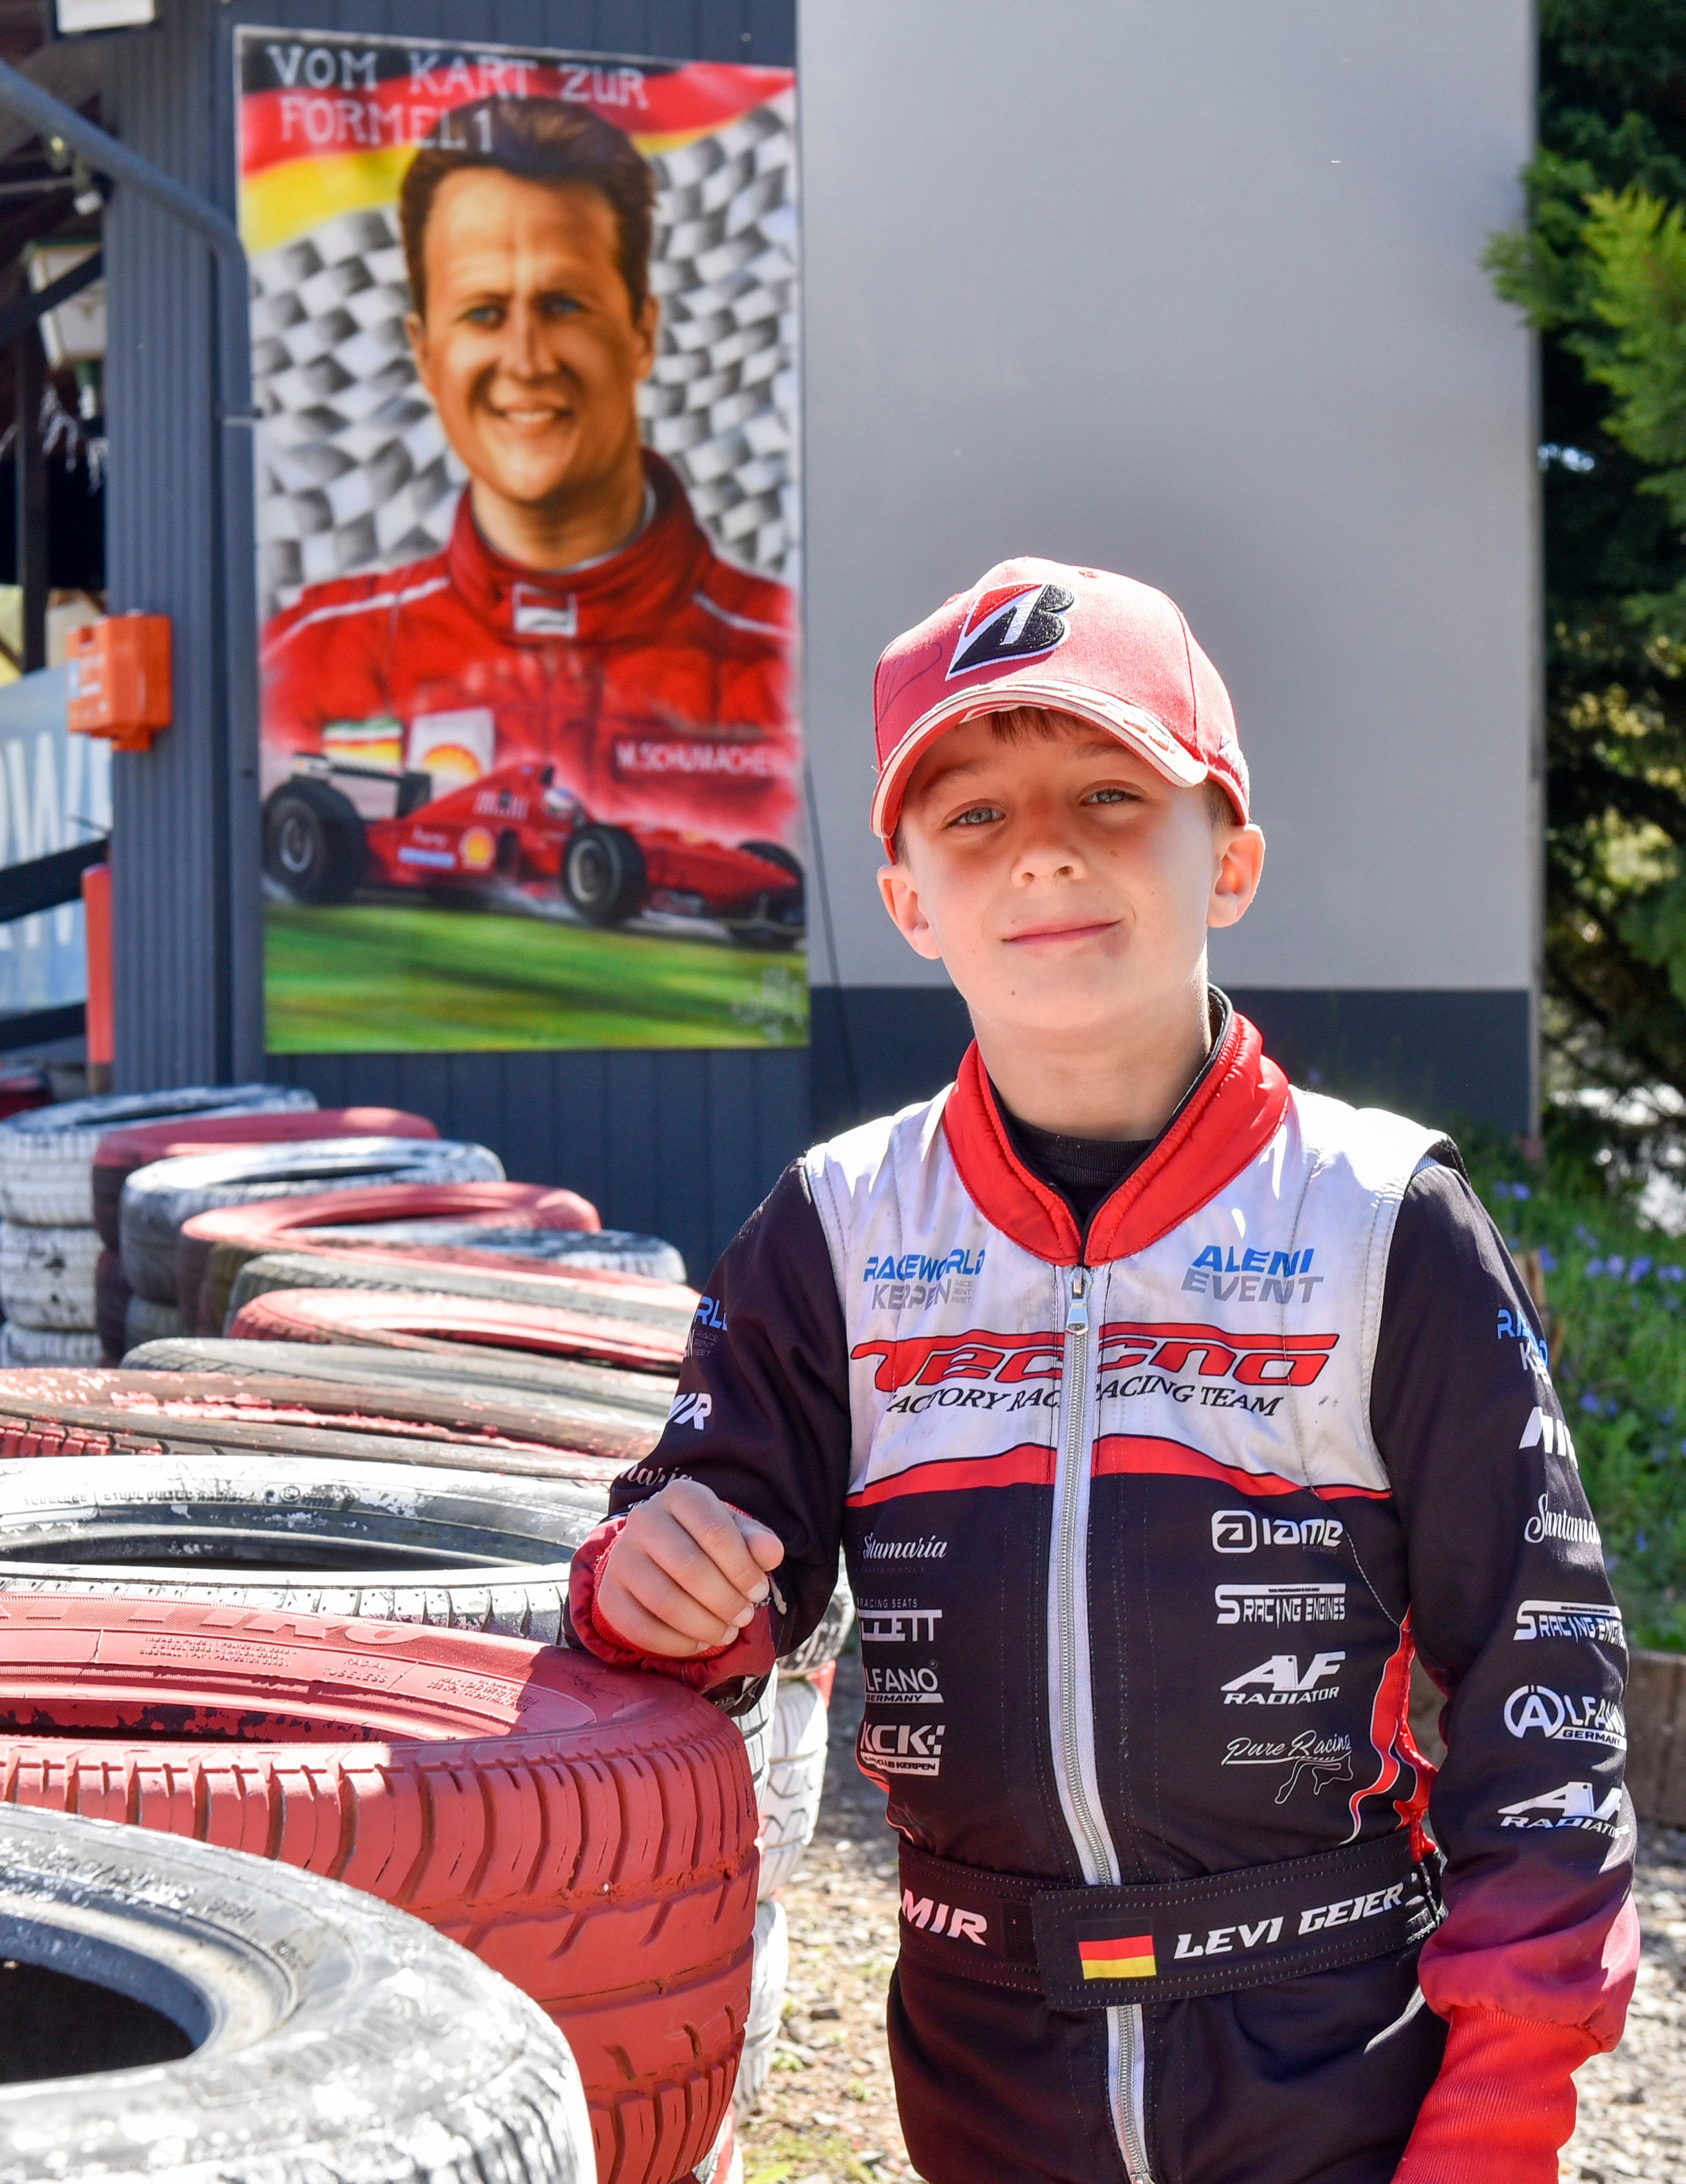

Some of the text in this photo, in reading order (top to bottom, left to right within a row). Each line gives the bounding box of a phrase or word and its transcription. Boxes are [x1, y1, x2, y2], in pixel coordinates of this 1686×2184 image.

[266, 44, 650, 110] VOM KART ZUR
[279, 95, 493, 154] FORMEL 1
[1192, 1245, 1314, 1277] ALENI
[1181, 1267, 1324, 1304] EVENT
[886, 1388, 1010, 1413] ACTORY
[1200, 1386, 1284, 1416] TEAM
[891, 1598, 918, 1608] SEATS
[863, 1668, 939, 1692] LFANO
[1223, 1686, 1340, 1705] RADIATOR
[1221, 1737, 1287, 1766] Pure
[1562, 1729, 1620, 1746] GERMANY
[1173, 1882, 1403, 1960] LEVI GEIER
